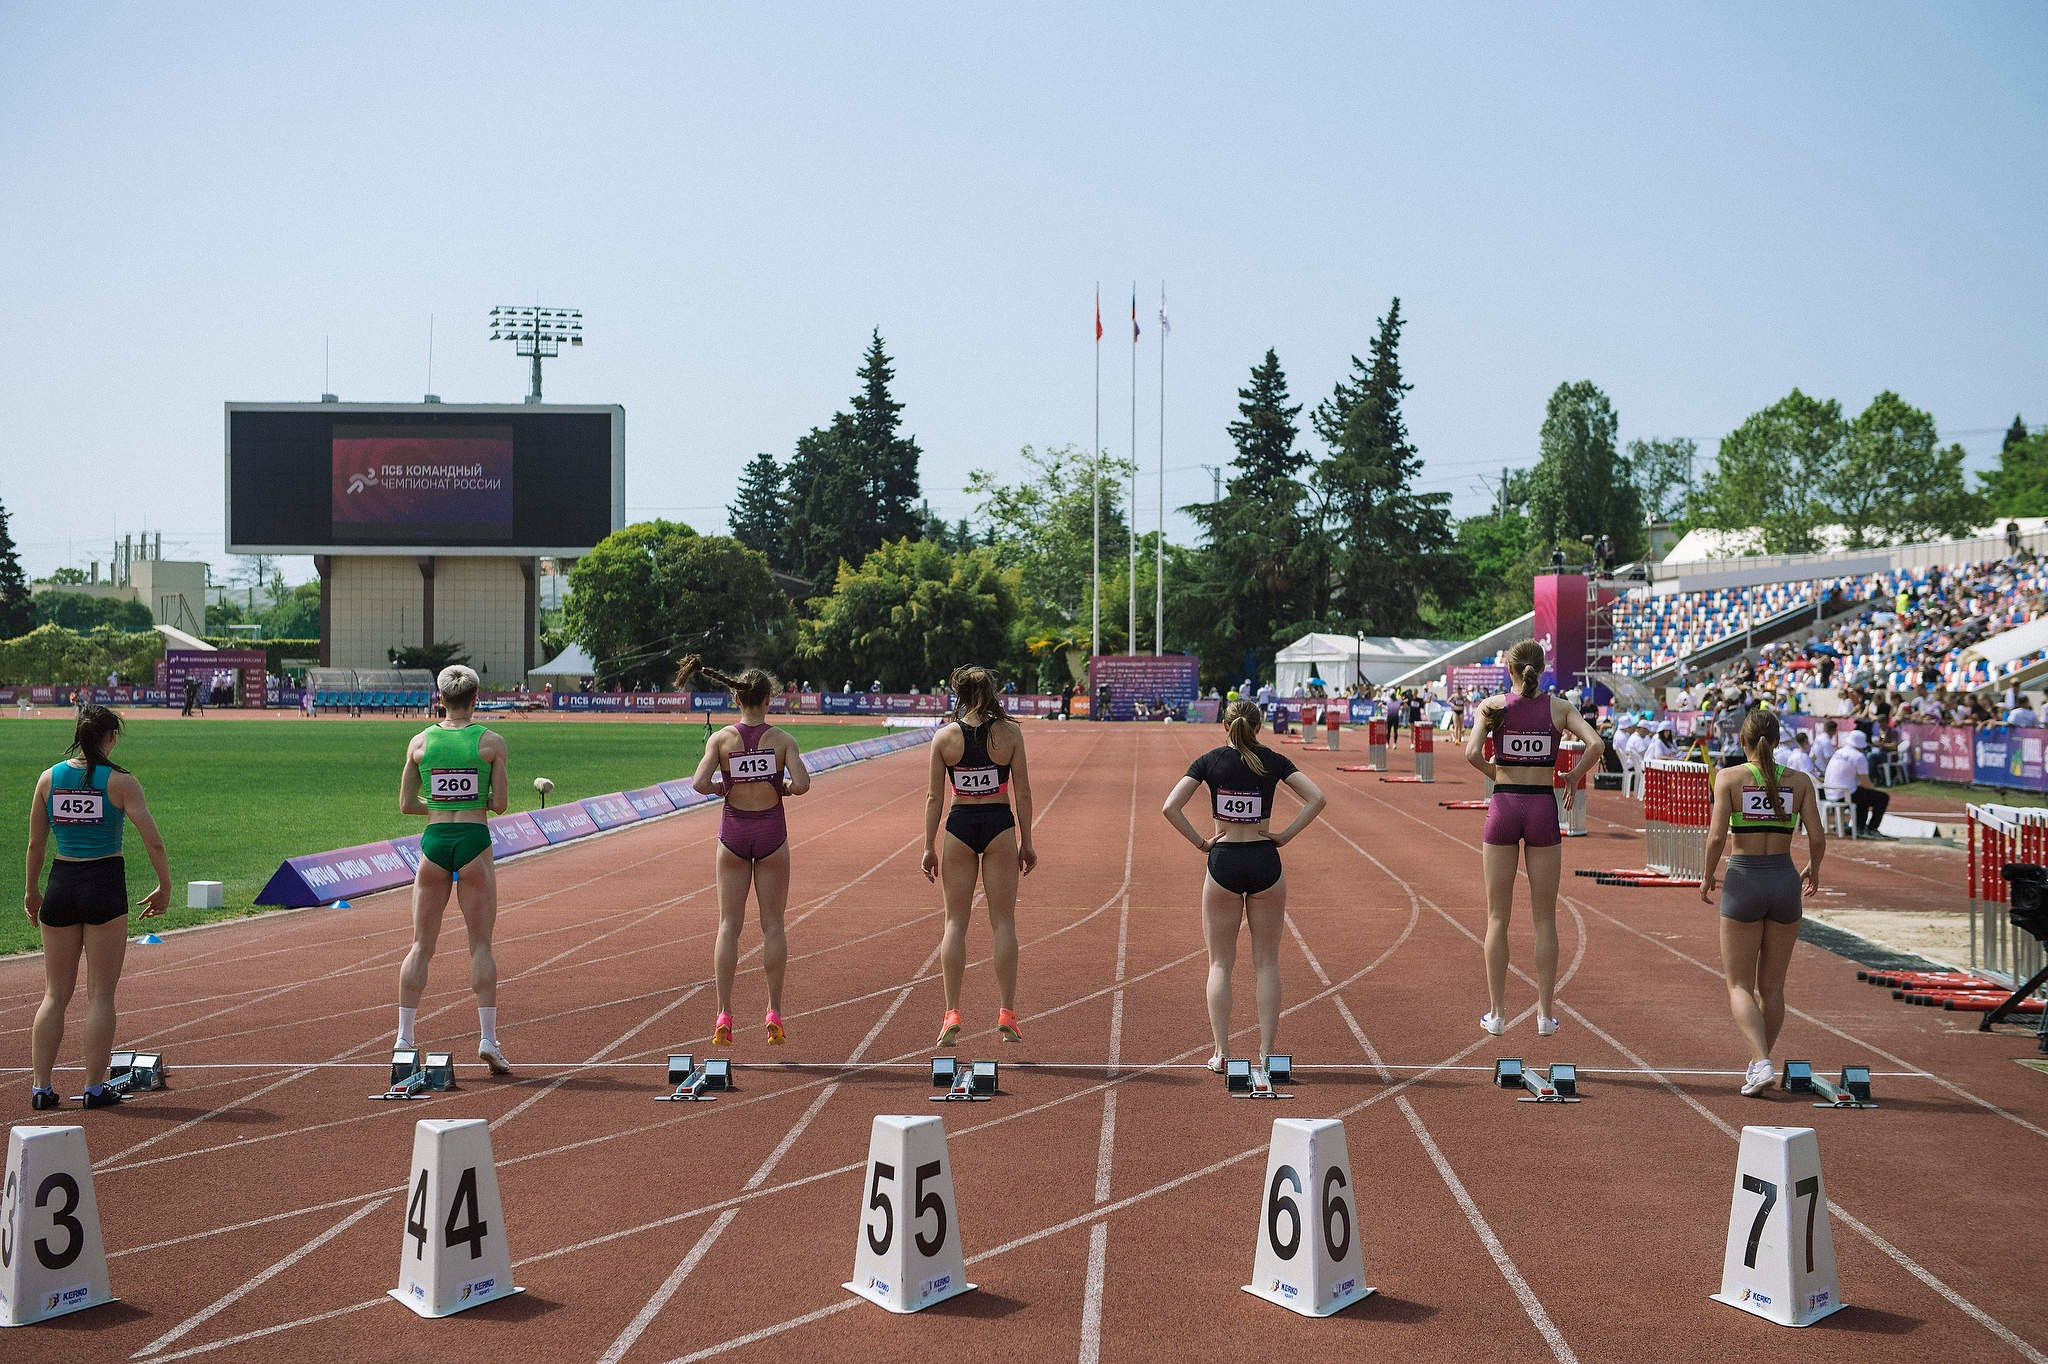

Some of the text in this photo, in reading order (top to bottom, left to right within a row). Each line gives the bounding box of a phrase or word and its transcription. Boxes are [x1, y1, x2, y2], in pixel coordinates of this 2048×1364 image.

[381, 463, 482, 477] ПСБ КОМАНДНЫЙ
[381, 479, 501, 490] ЧЕМПИОНАТ РОССИИ
[146, 690, 167, 699] ПСБ
[570, 696, 687, 705] ПСБ FONBET ПСБ FONBET
[1511, 739, 1543, 752] 010
[739, 759, 768, 773] 413
[438, 778, 472, 791] 260
[962, 774, 991, 787] 214
[60, 799, 95, 814] 452
[1224, 799, 1253, 814] 491
[407, 1168, 429, 1261] 4
[445, 1166, 488, 1260] 4
[867, 1161, 895, 1257] 5
[914, 1160, 947, 1258] 5
[1268, 1164, 1303, 1261] 6
[1322, 1165, 1351, 1263] 6
[2, 1170, 17, 1269] 3
[34, 1172, 84, 1270] 3
[1742, 1173, 1777, 1270] 7
[1795, 1175, 1819, 1274] 7
[474, 1278, 495, 1292] KERKO
[1281, 1283, 1298, 1296] KERKO
[62, 1287, 88, 1302] KERKO
[1752, 1291, 1772, 1305] KERKO
